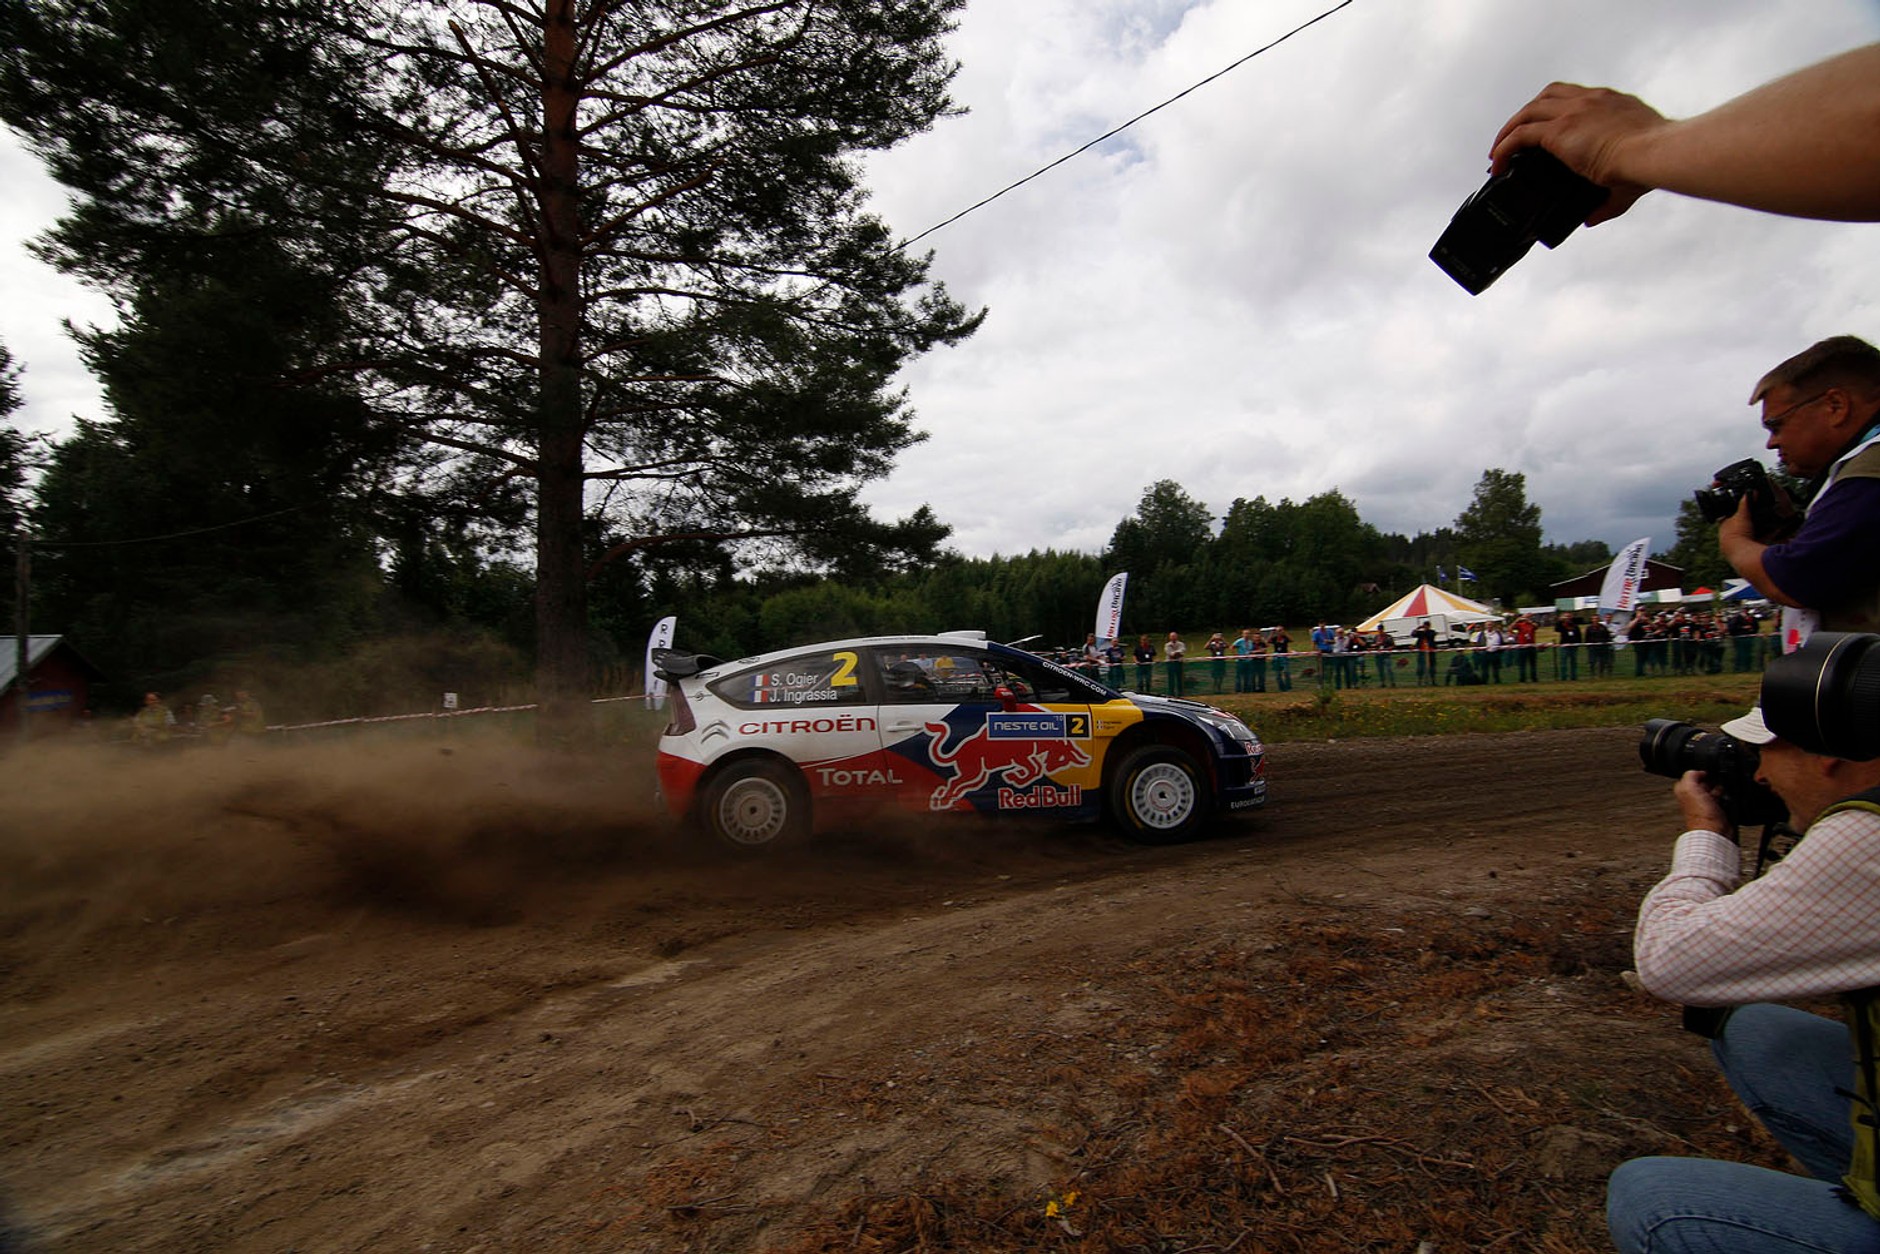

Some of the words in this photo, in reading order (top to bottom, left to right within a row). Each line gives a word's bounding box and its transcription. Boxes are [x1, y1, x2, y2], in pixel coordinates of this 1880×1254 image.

[831, 651, 858, 687] 2
[771, 673, 782, 686] S.
[786, 672, 819, 688] Ogier
[769, 690, 781, 702] J.
[783, 688, 838, 703] Ingrassia
[993, 721, 1038, 731] NESTE
[1039, 721, 1059, 731] OIL
[1071, 717, 1085, 735] 2
[816, 768, 903, 786] TOTAL
[998, 787, 1039, 809] Red
[1040, 784, 1081, 807] Bull
